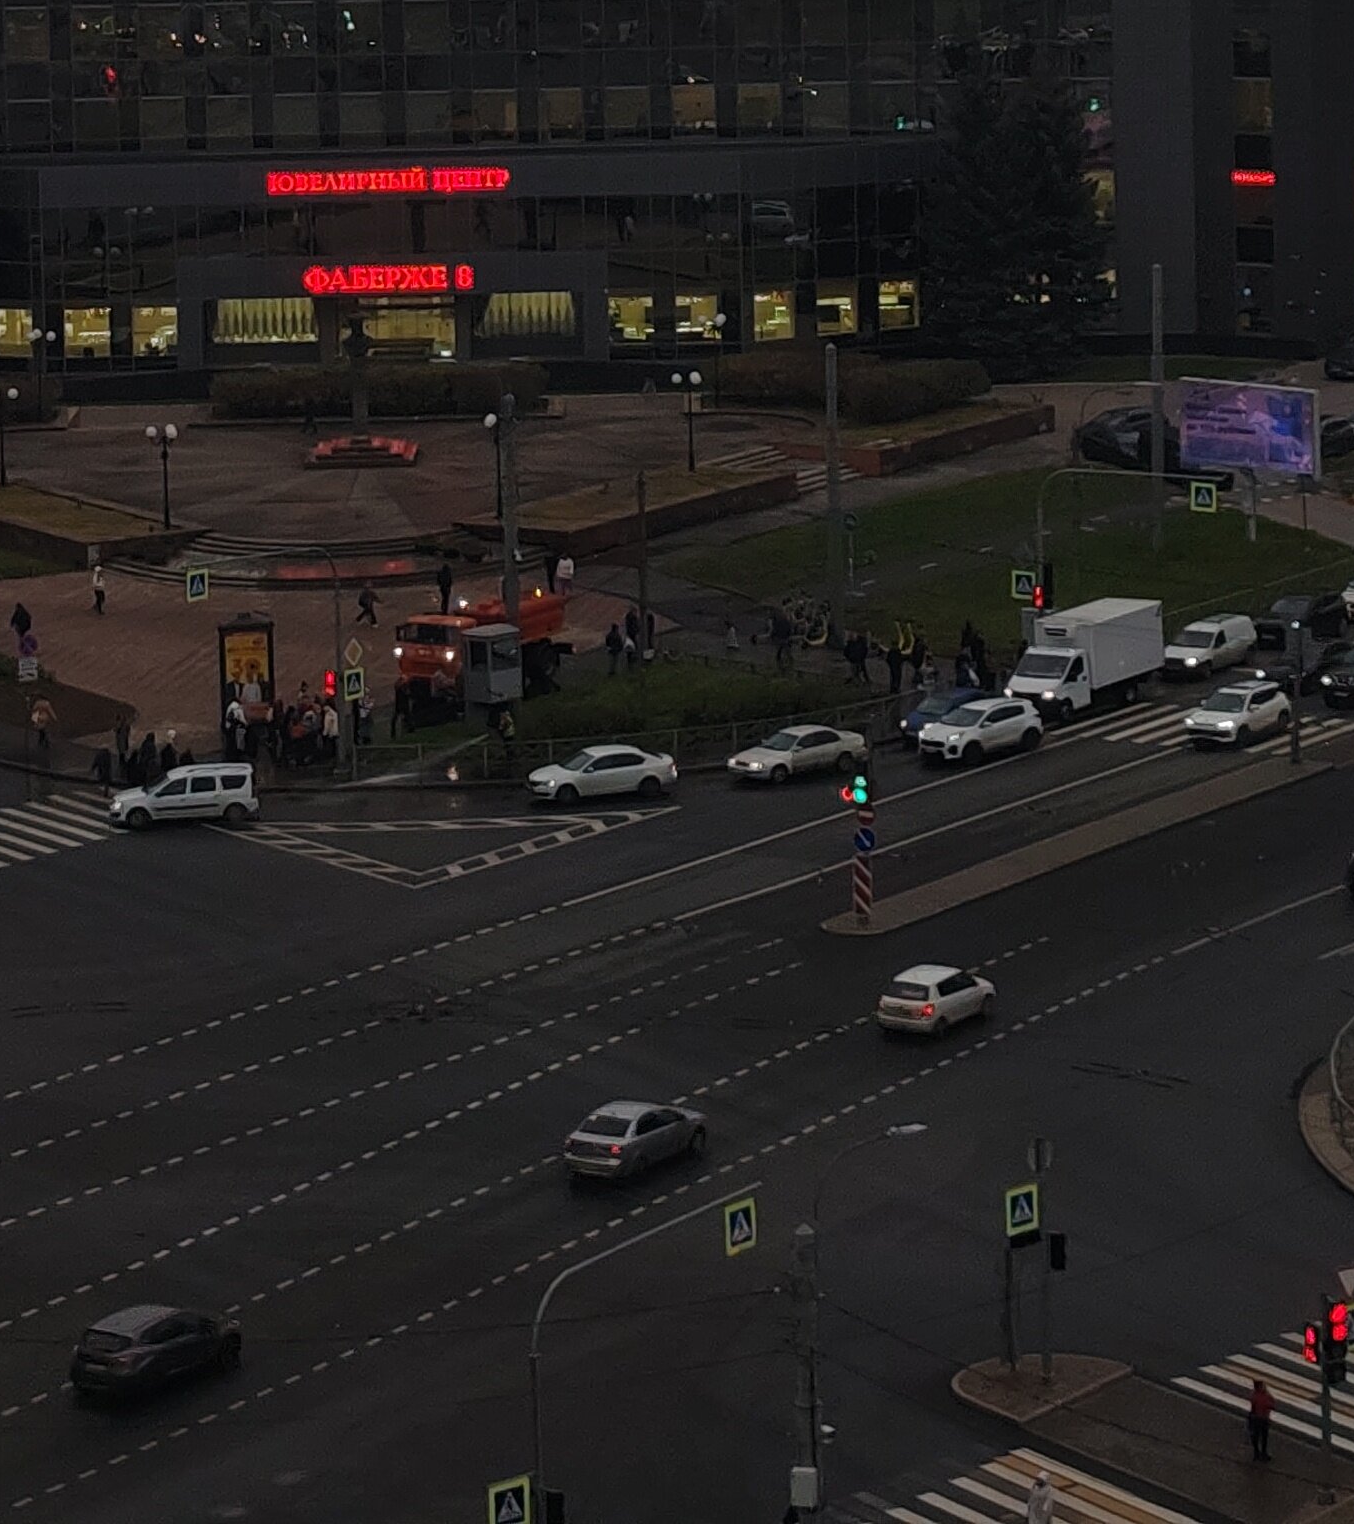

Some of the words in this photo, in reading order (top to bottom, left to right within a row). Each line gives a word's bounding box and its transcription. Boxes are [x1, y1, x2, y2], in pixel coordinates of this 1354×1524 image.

[267, 165, 429, 196] ЮВЕЛИРНЫЙ
[432, 166, 510, 194] ЦЕНТР
[303, 263, 448, 294] ФАБЕРЖЕ
[454, 264, 474, 290] 8
